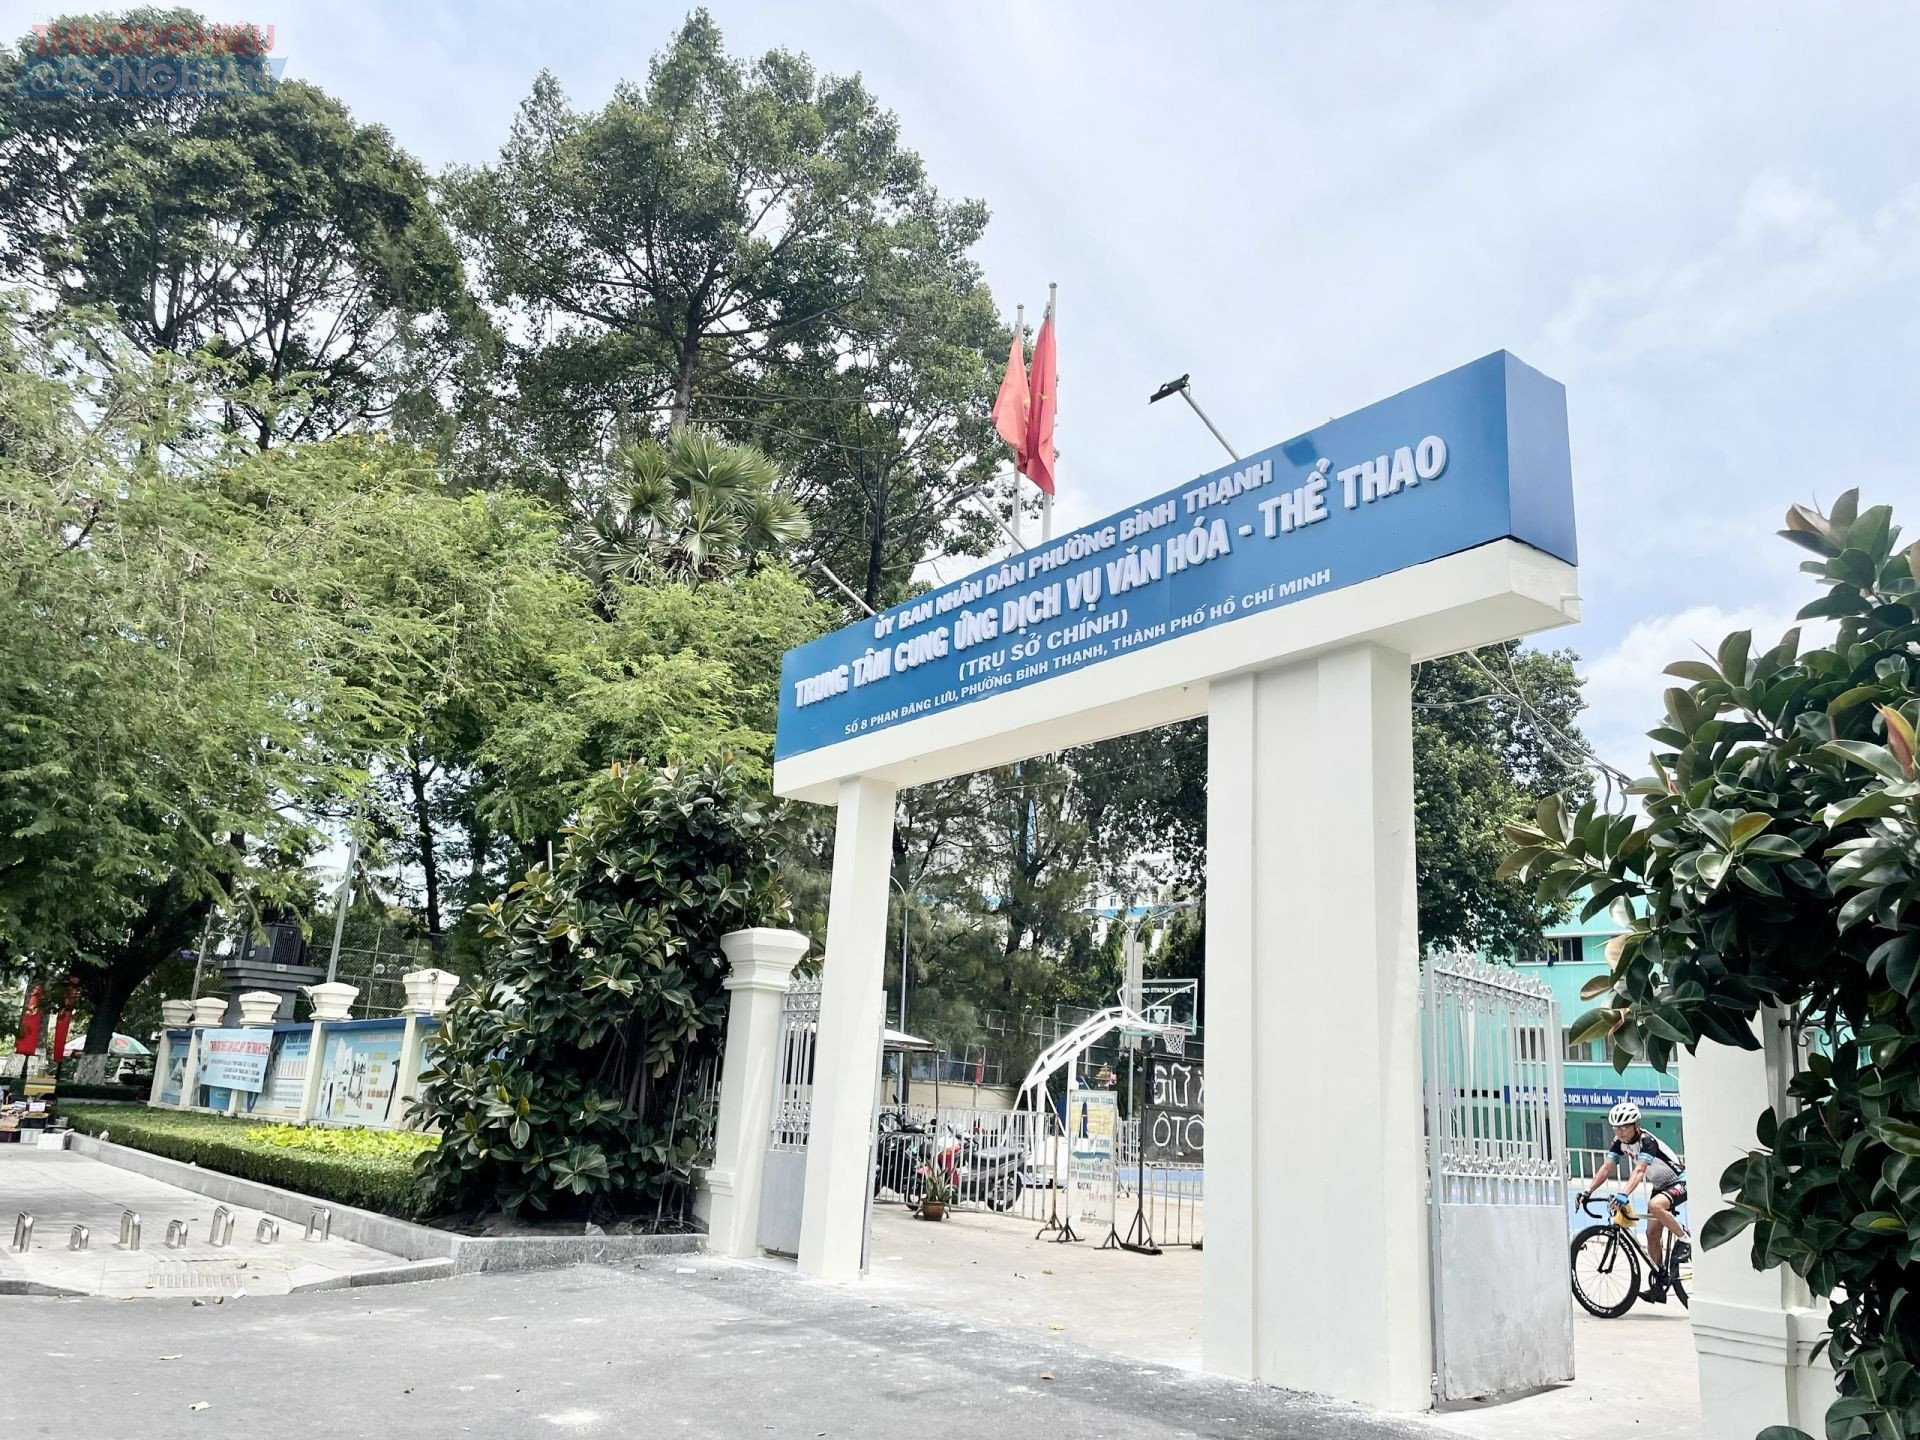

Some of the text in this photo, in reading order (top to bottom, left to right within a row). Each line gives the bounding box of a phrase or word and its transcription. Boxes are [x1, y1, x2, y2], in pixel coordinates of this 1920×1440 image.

[795, 435, 1447, 708] TRUNG TÂM CUNG ỨNG DỊCH VỤ VĂN HÓA - THỂ THAO
[899, 600, 933, 630] BAN
[936, 581, 983, 615] NHÂN
[986, 563, 1025, 595] DÂN
[1028, 525, 1116, 578] PHƯỜNG
[1119, 500, 1176, 542] BÌNH
[1182, 459, 1273, 514] THẠNH
[844, 568, 1331, 735] SỐ 8 PHAN ĐĂNG LƯU, PHƯỜNG BÌNH THẠNH, THÀNH PHỐ HỒ CHÍ MINH
[958, 609, 1128, 681] (TRỤ SỞ CHÍNH)
[1568, 1095, 1581, 1105] DỊCH
[1590, 1092, 1601, 1105] VĂN
[1630, 1096, 1645, 1106] THAO
